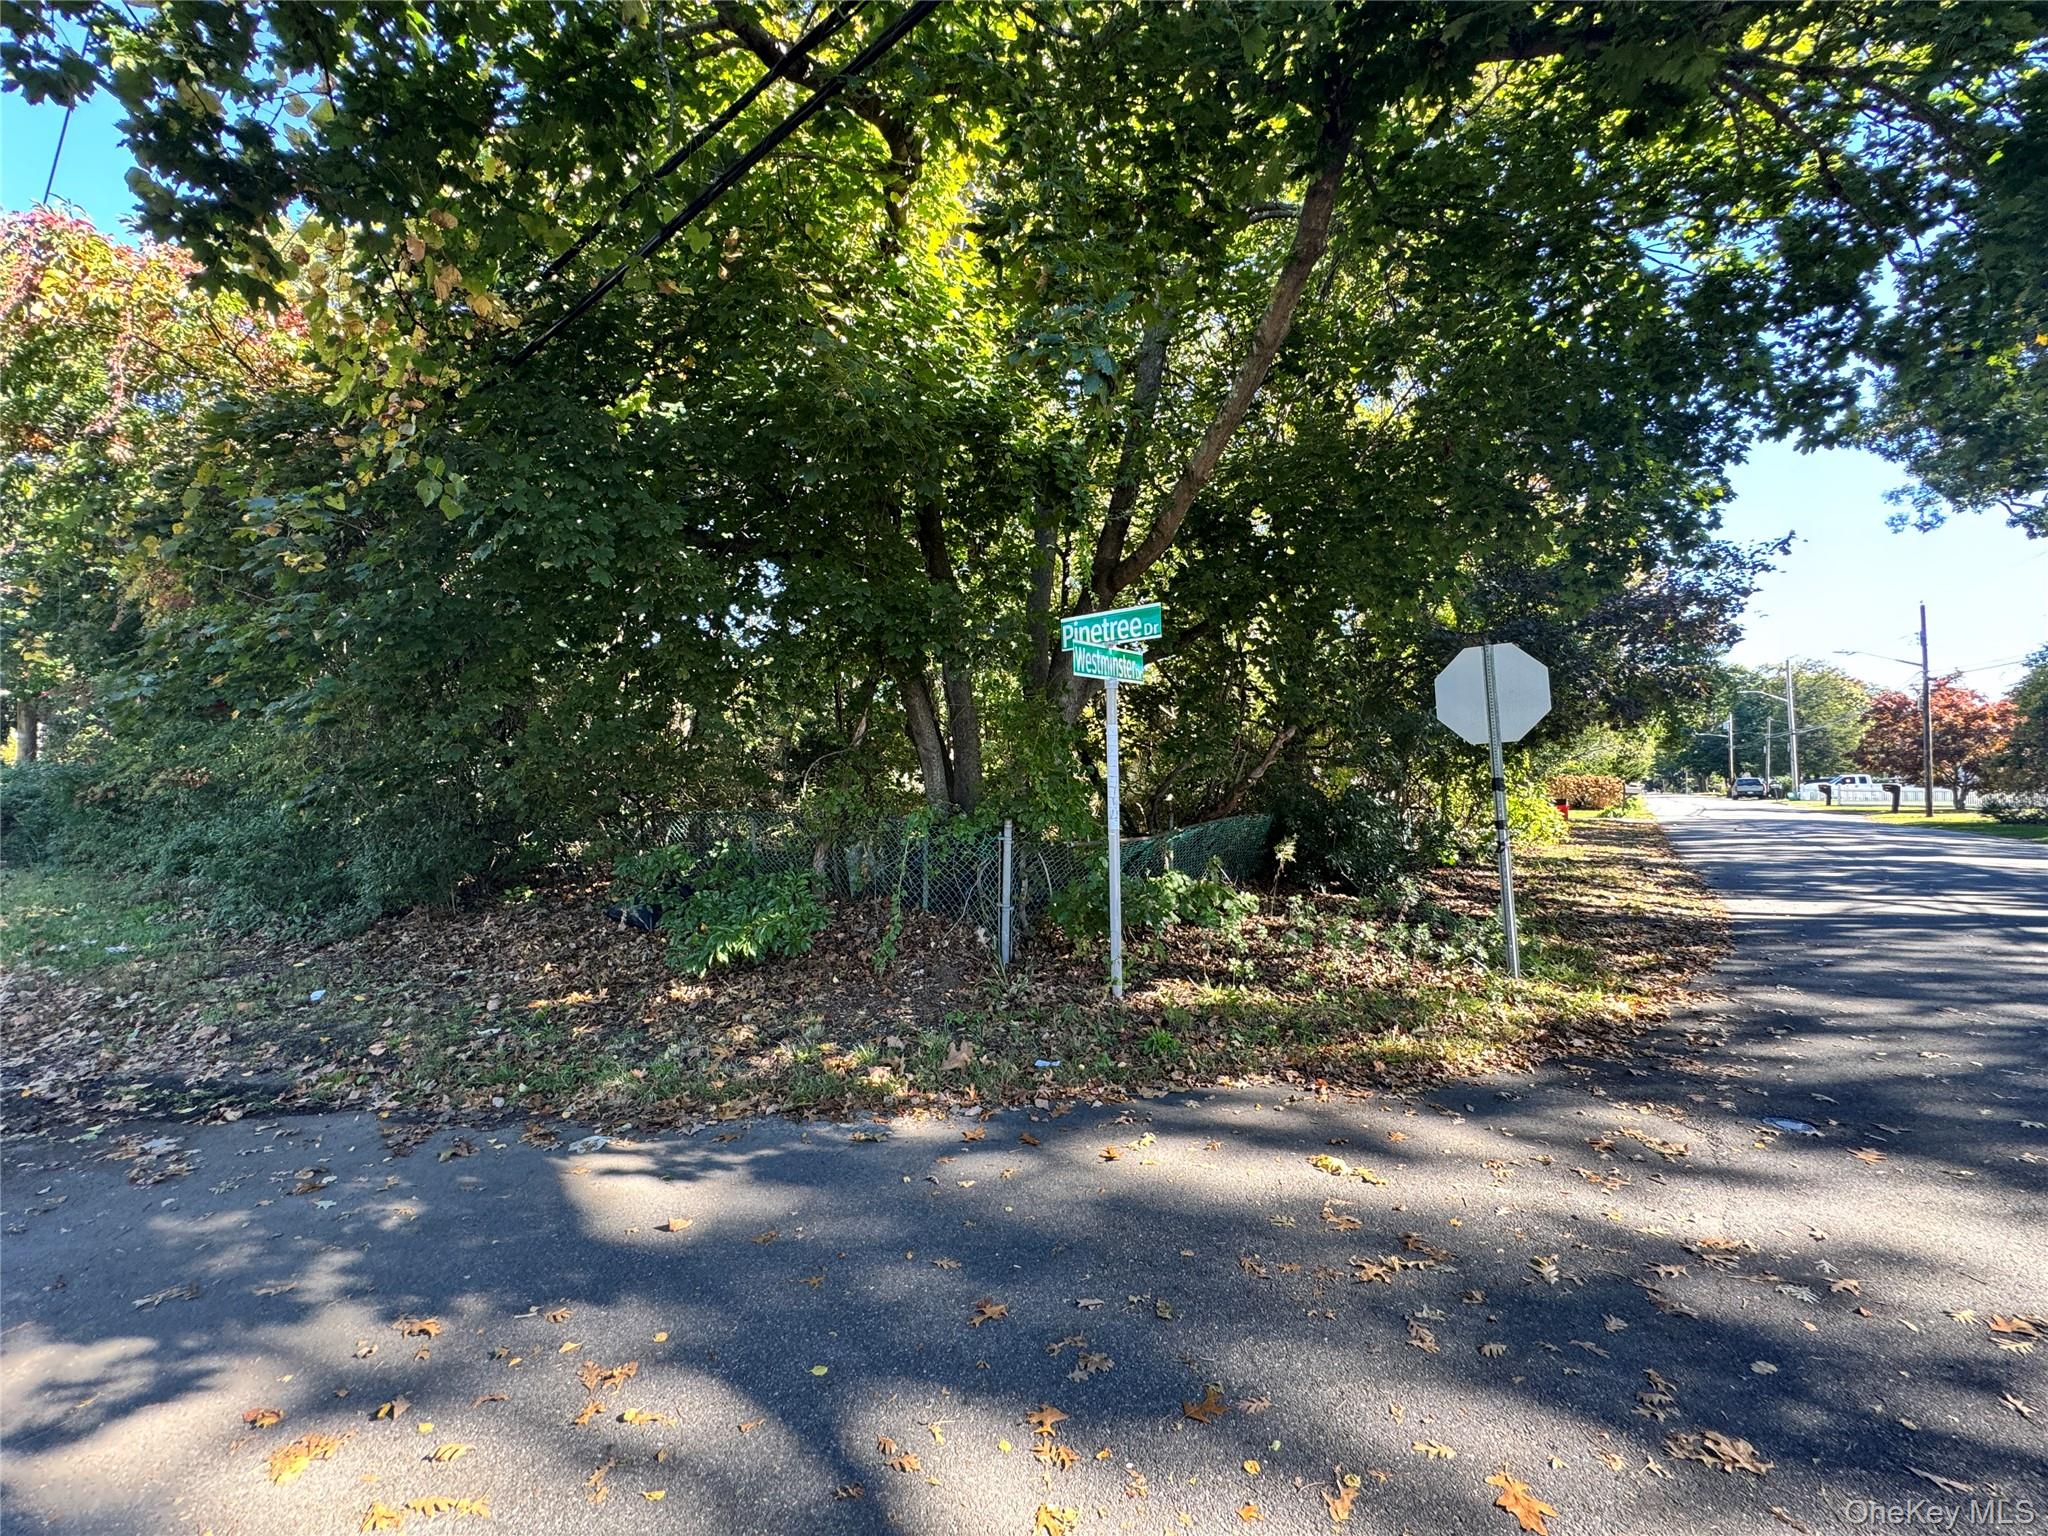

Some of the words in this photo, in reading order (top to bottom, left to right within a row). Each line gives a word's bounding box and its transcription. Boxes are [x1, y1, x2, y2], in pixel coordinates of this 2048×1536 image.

[1063, 617, 1142, 648] Pinetree
[1144, 623, 1159, 636] Dr
[1075, 647, 1137, 679] Westminster
